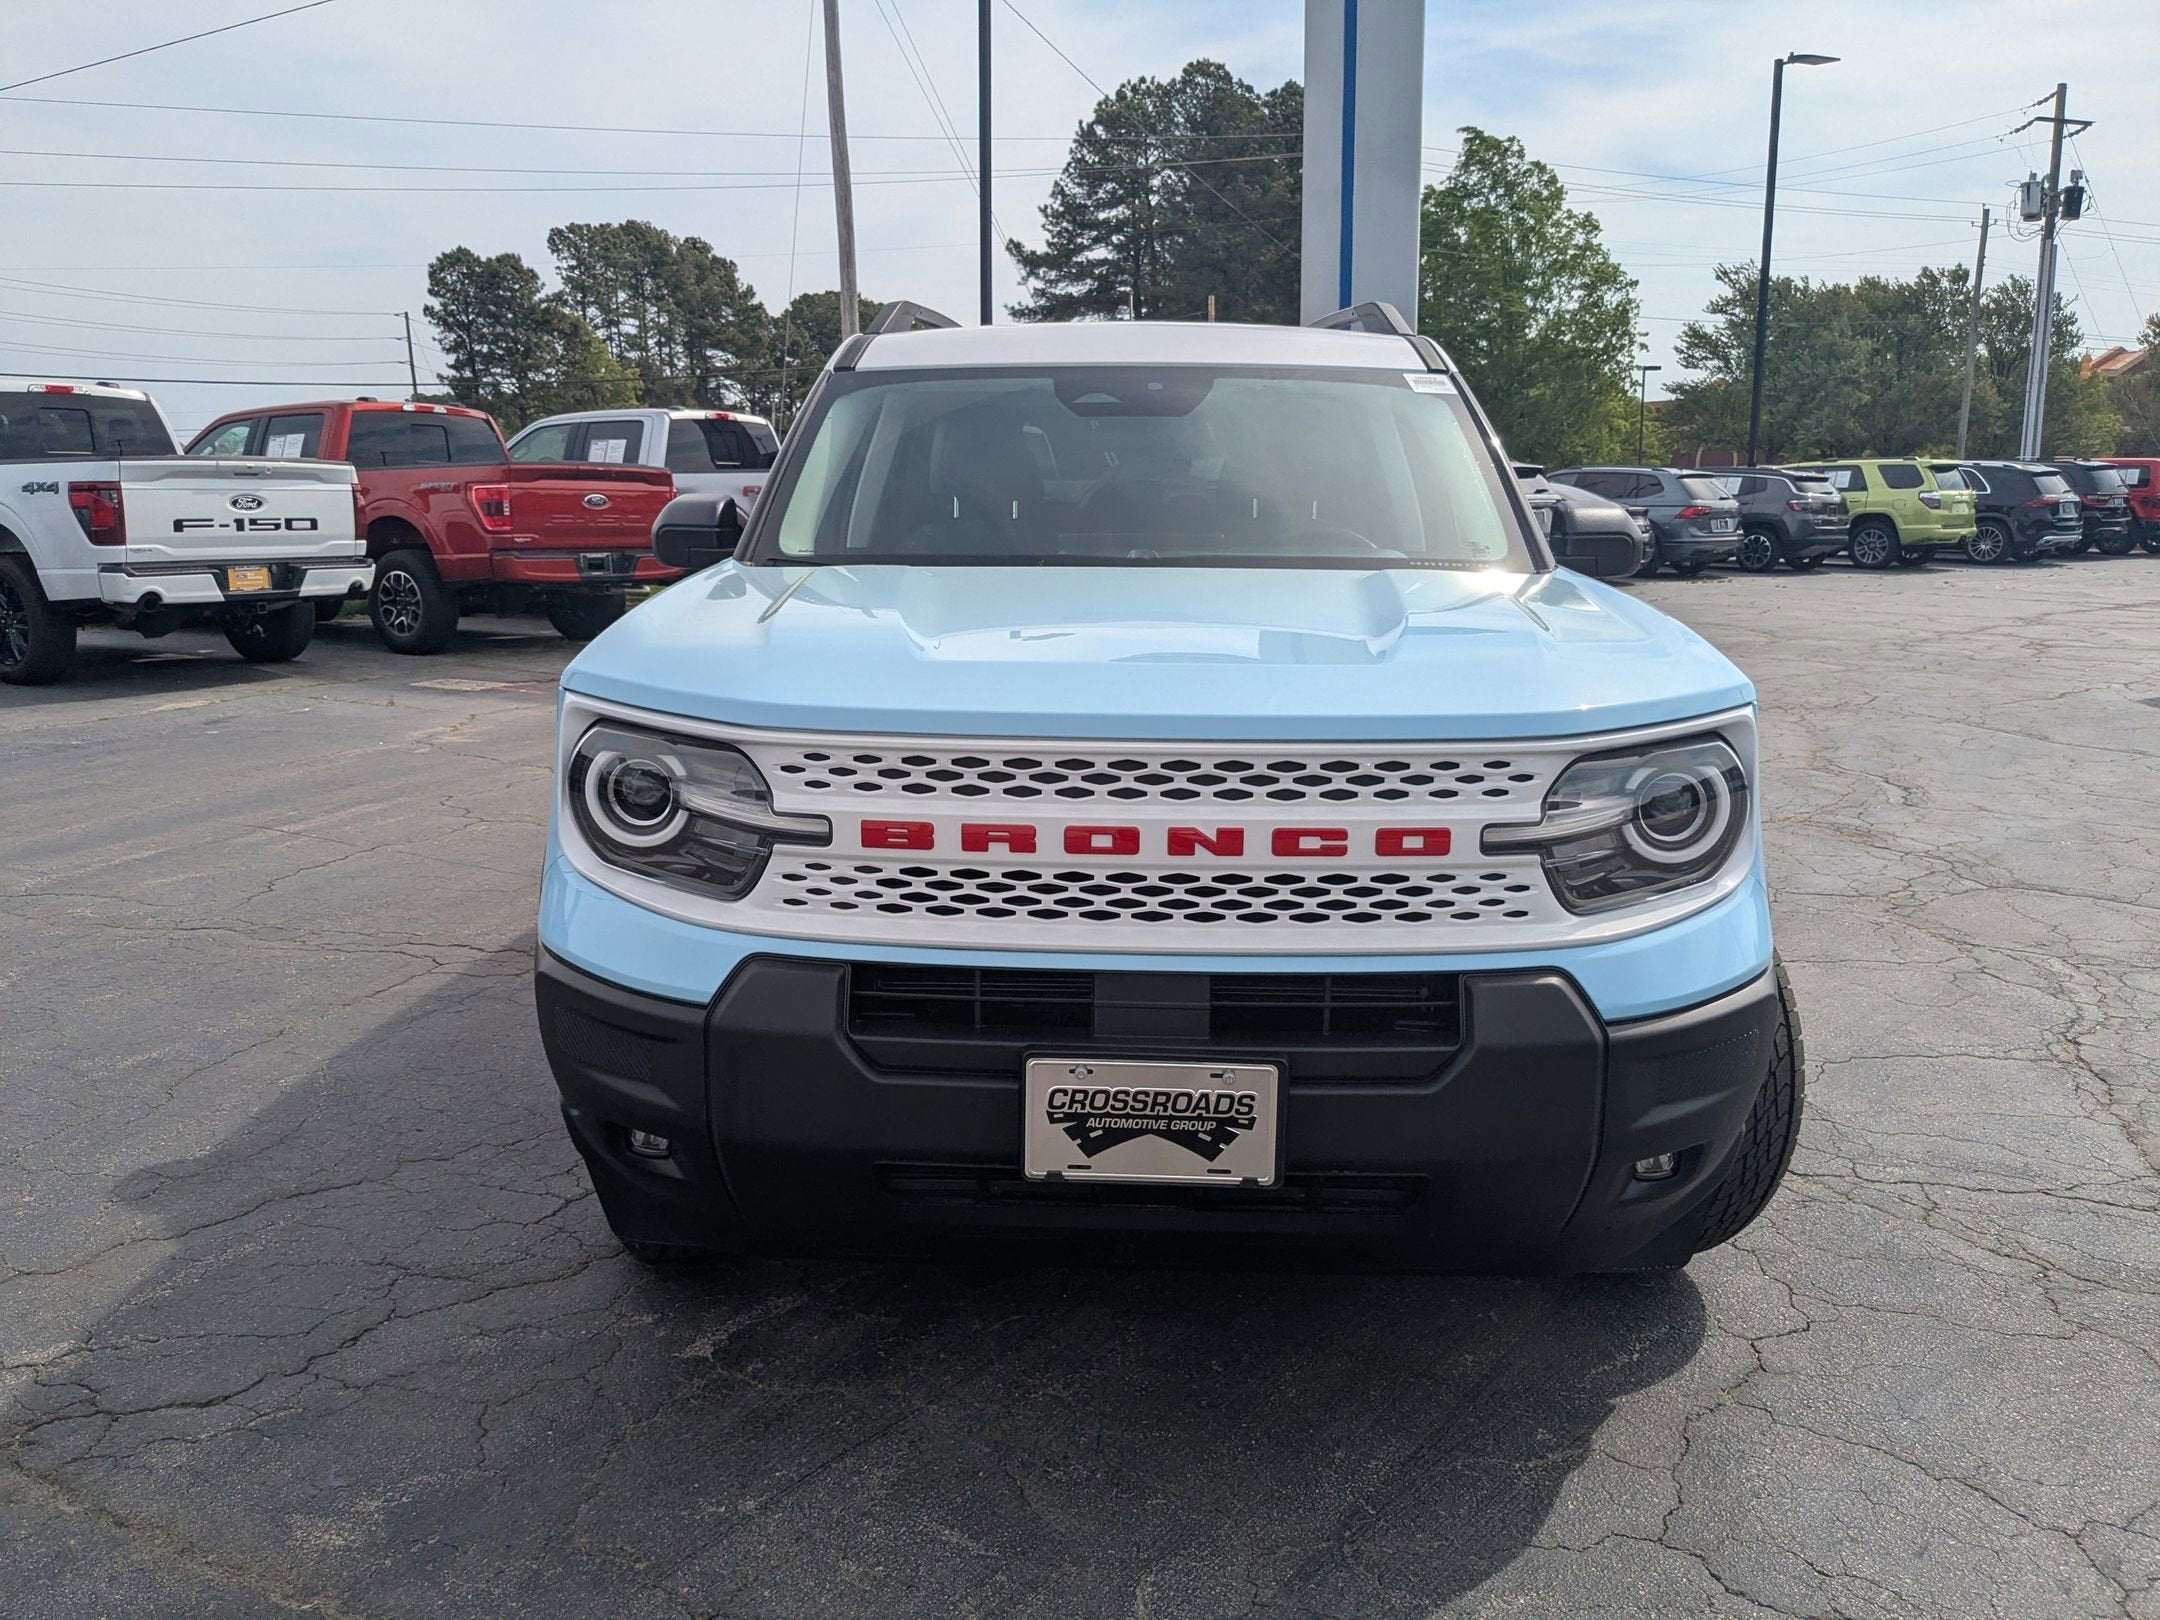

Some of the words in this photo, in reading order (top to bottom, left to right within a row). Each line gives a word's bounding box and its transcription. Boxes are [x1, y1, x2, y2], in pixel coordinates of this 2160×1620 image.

[235, 498, 258, 509] Ford
[173, 517, 318, 533] F-150
[860, 819, 1451, 857] BRONCO
[1047, 1088, 1256, 1116] CROSSROADS
[1085, 1117, 1168, 1131] AUTOMOTIVE
[1170, 1118, 1217, 1132] GROUP
